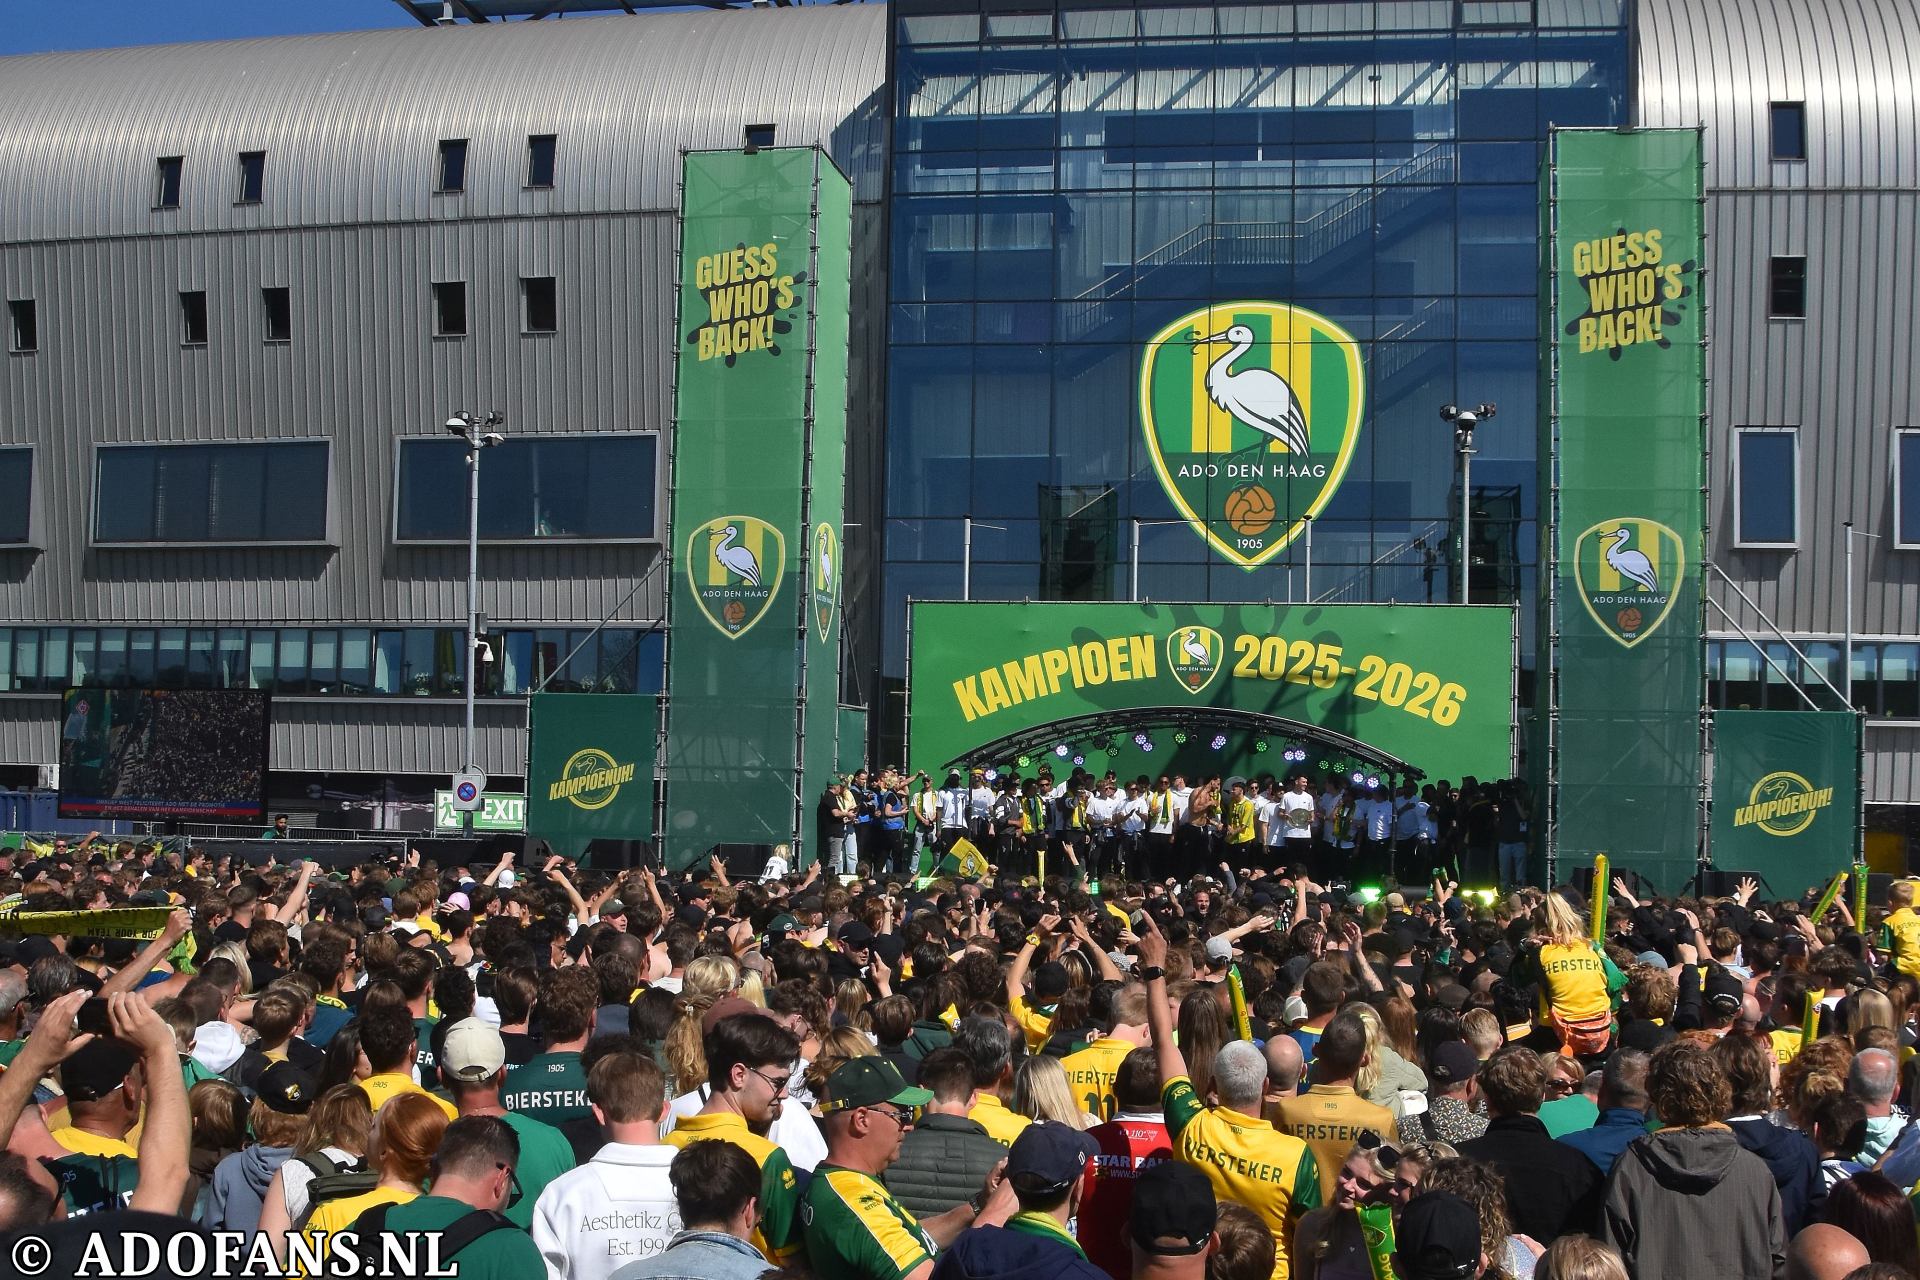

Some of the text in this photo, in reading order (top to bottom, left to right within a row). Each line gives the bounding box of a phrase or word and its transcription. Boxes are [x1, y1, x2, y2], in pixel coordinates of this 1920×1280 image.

[1573, 229, 1662, 278] GUESS
[696, 243, 777, 290] GUESS
[709, 275, 794, 323] WHO'S
[1589, 264, 1683, 313] WHO'S
[698, 314, 774, 361] BACK!
[1579, 305, 1662, 353] BACK!
[1178, 464, 1327, 478] ADO DEN HAAG
[1236, 538, 1263, 549] 1905
[702, 590, 769, 598] ADO DEN HAAG
[1593, 596, 1667, 604] ADO DEN HAAG
[953, 633, 1467, 727] KAMPIOEN 2025-2026
[549, 763, 635, 801] KAMPIOENUH!
[481, 798, 524, 820] EXIT
[1734, 787, 1834, 827] KAMPIOENUH!
[547, 1063, 565, 1073] 1905
[372, 1081, 389, 1089] 1905
[1324, 1102, 1338, 1110] 1905
[1093, 1154, 1131, 1168] STAR
[1184, 1136, 1283, 1184] BIERSTEKER
[580, 1210, 684, 1233] Aesthetikz C
[607, 1238, 634, 1256] Est.
